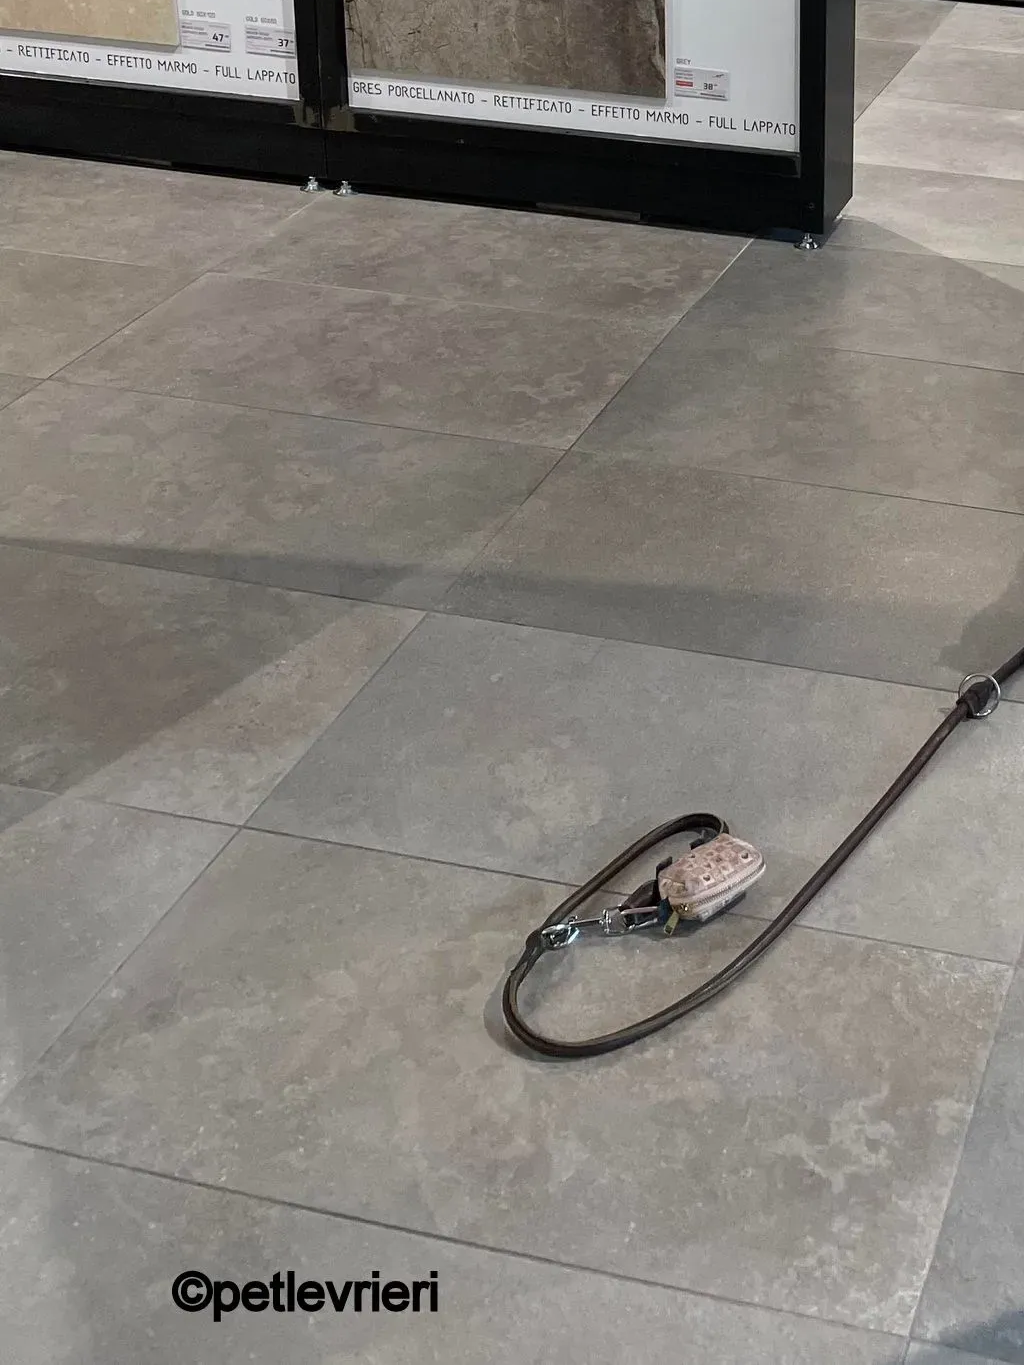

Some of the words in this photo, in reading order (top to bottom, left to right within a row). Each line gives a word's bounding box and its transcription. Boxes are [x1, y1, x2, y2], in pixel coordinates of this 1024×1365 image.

[17, 44, 90, 63] RETTIFICATO
[107, 54, 152, 71] EFFETTO
[157, 60, 198, 75] MARMO
[215, 65, 242, 80] FULL
[247, 67, 297, 85] LAPPATO
[352, 81, 382, 95] GRES
[388, 84, 475, 105] PORCELLANATO
[493, 94, 573, 114] RETTIFICATO
[591, 104, 640, 121] EFFETTO
[646, 109, 690, 125] MARMO
[709, 115, 737, 131] FULL
[743, 118, 797, 136] LAPPATO
